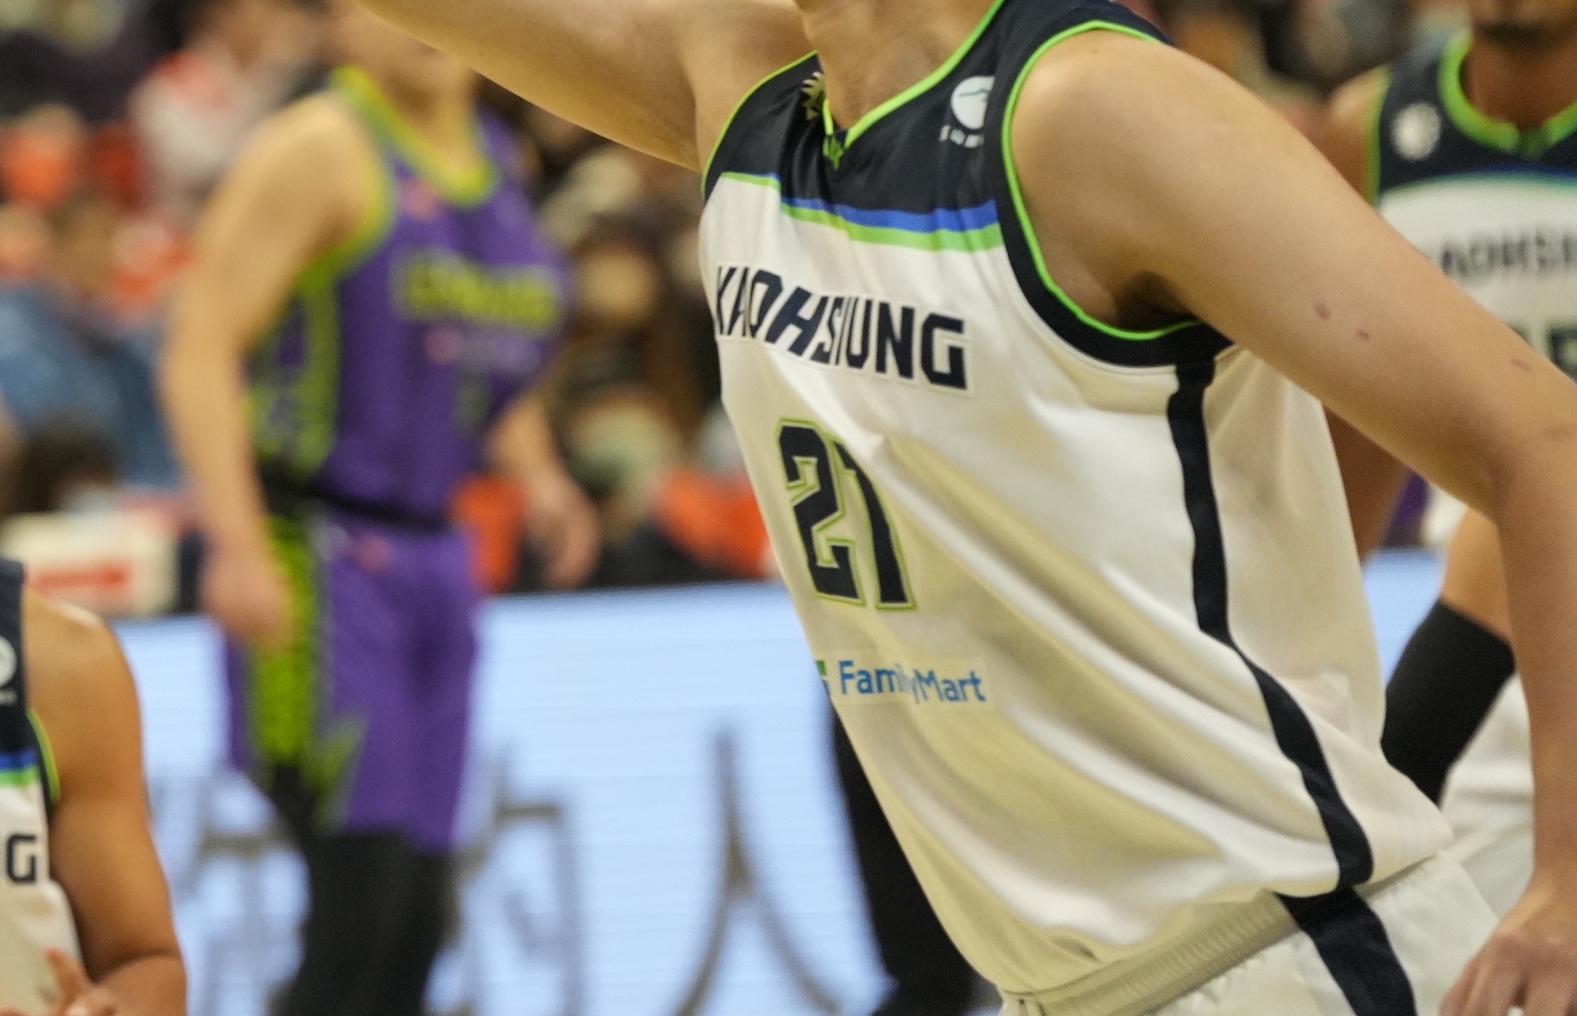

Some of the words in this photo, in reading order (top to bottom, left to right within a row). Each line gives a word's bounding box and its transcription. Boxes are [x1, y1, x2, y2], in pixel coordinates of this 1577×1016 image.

[715, 264, 968, 390] KAOHSIUNG
[778, 419, 916, 611] 21
[838, 660, 986, 705] FamyMart
